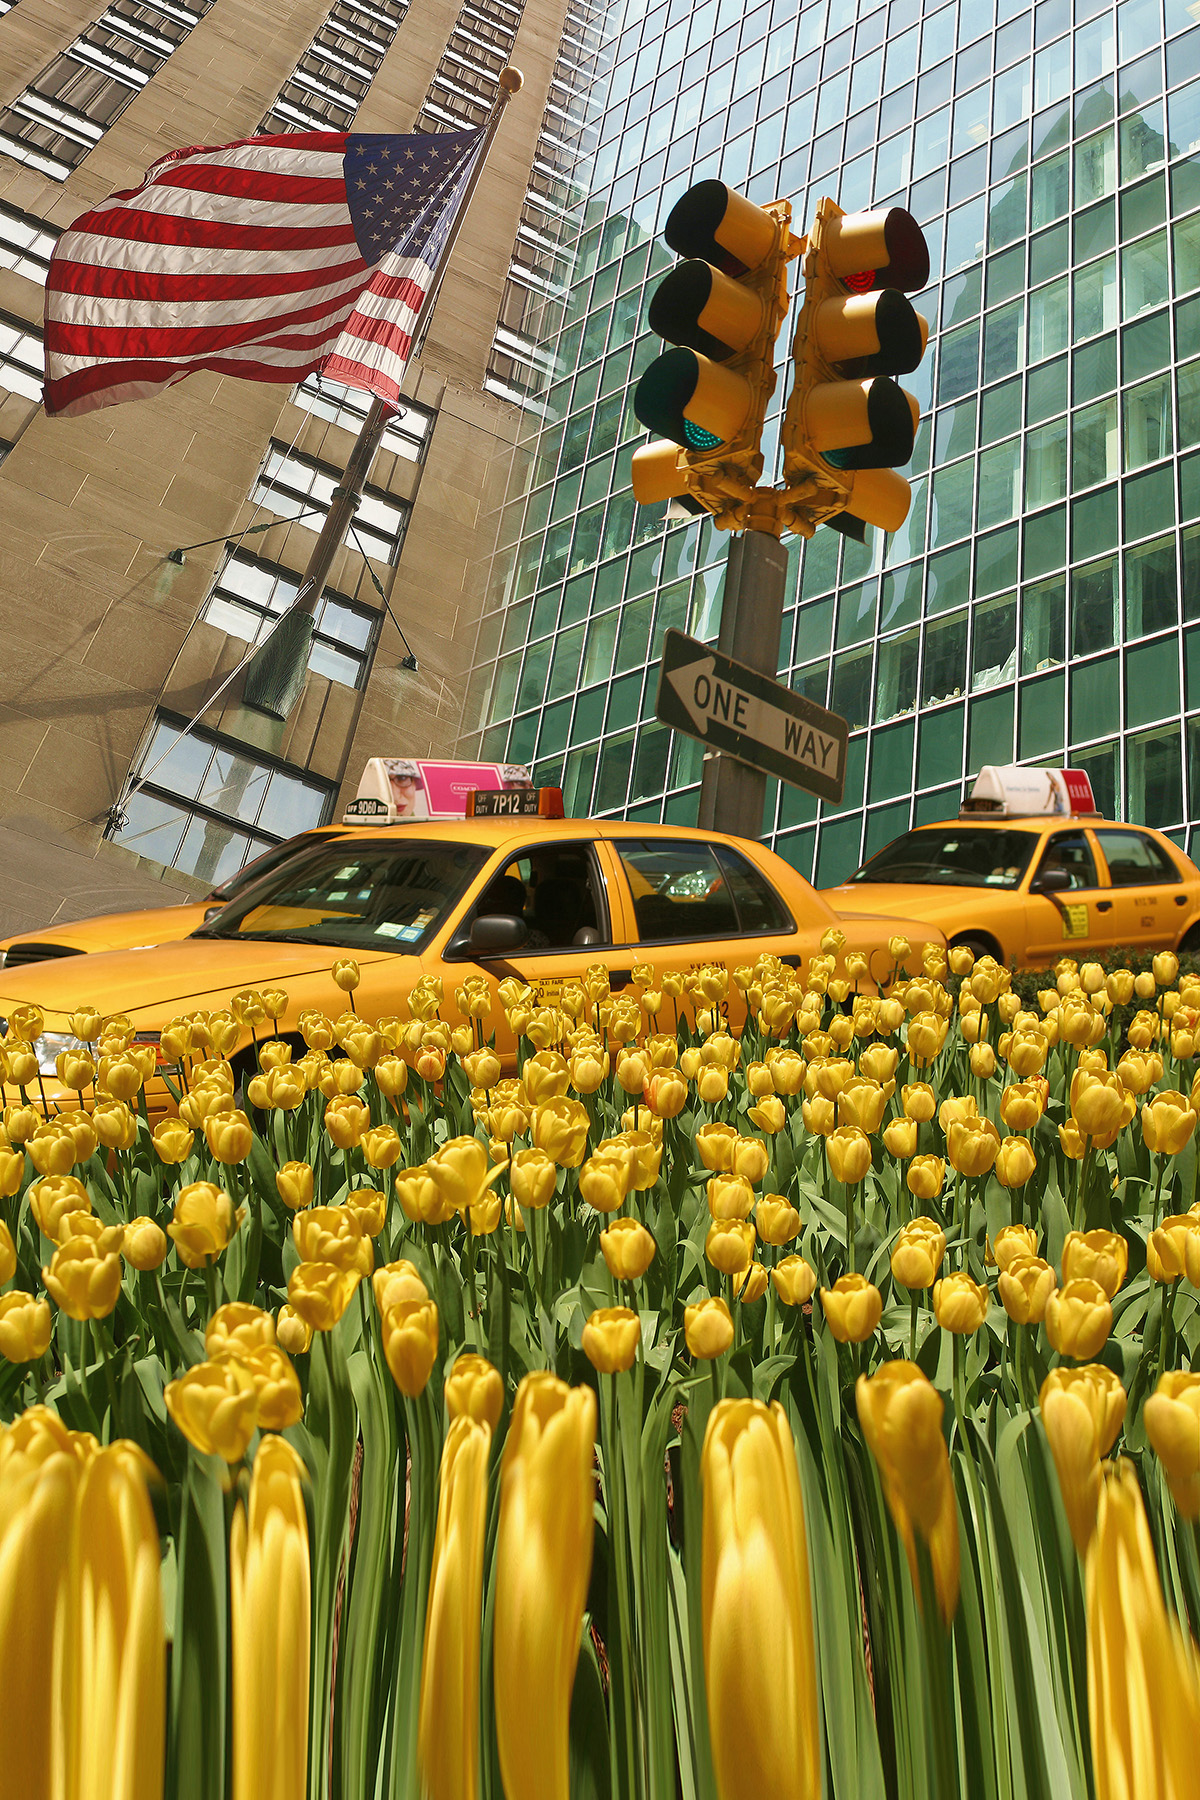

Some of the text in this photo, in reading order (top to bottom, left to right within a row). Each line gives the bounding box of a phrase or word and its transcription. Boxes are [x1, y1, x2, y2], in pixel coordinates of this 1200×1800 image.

[693, 675, 834, 769] ONE WAY
[477, 794, 488, 803] OFF
[526, 792, 536, 801] OFF
[347, 805, 358, 813] OFF
[358, 800, 377, 815] 9D60
[492, 794, 520, 814] 7P12
[524, 804, 537, 813] DUTY
[475, 805, 488, 814] DUTY
